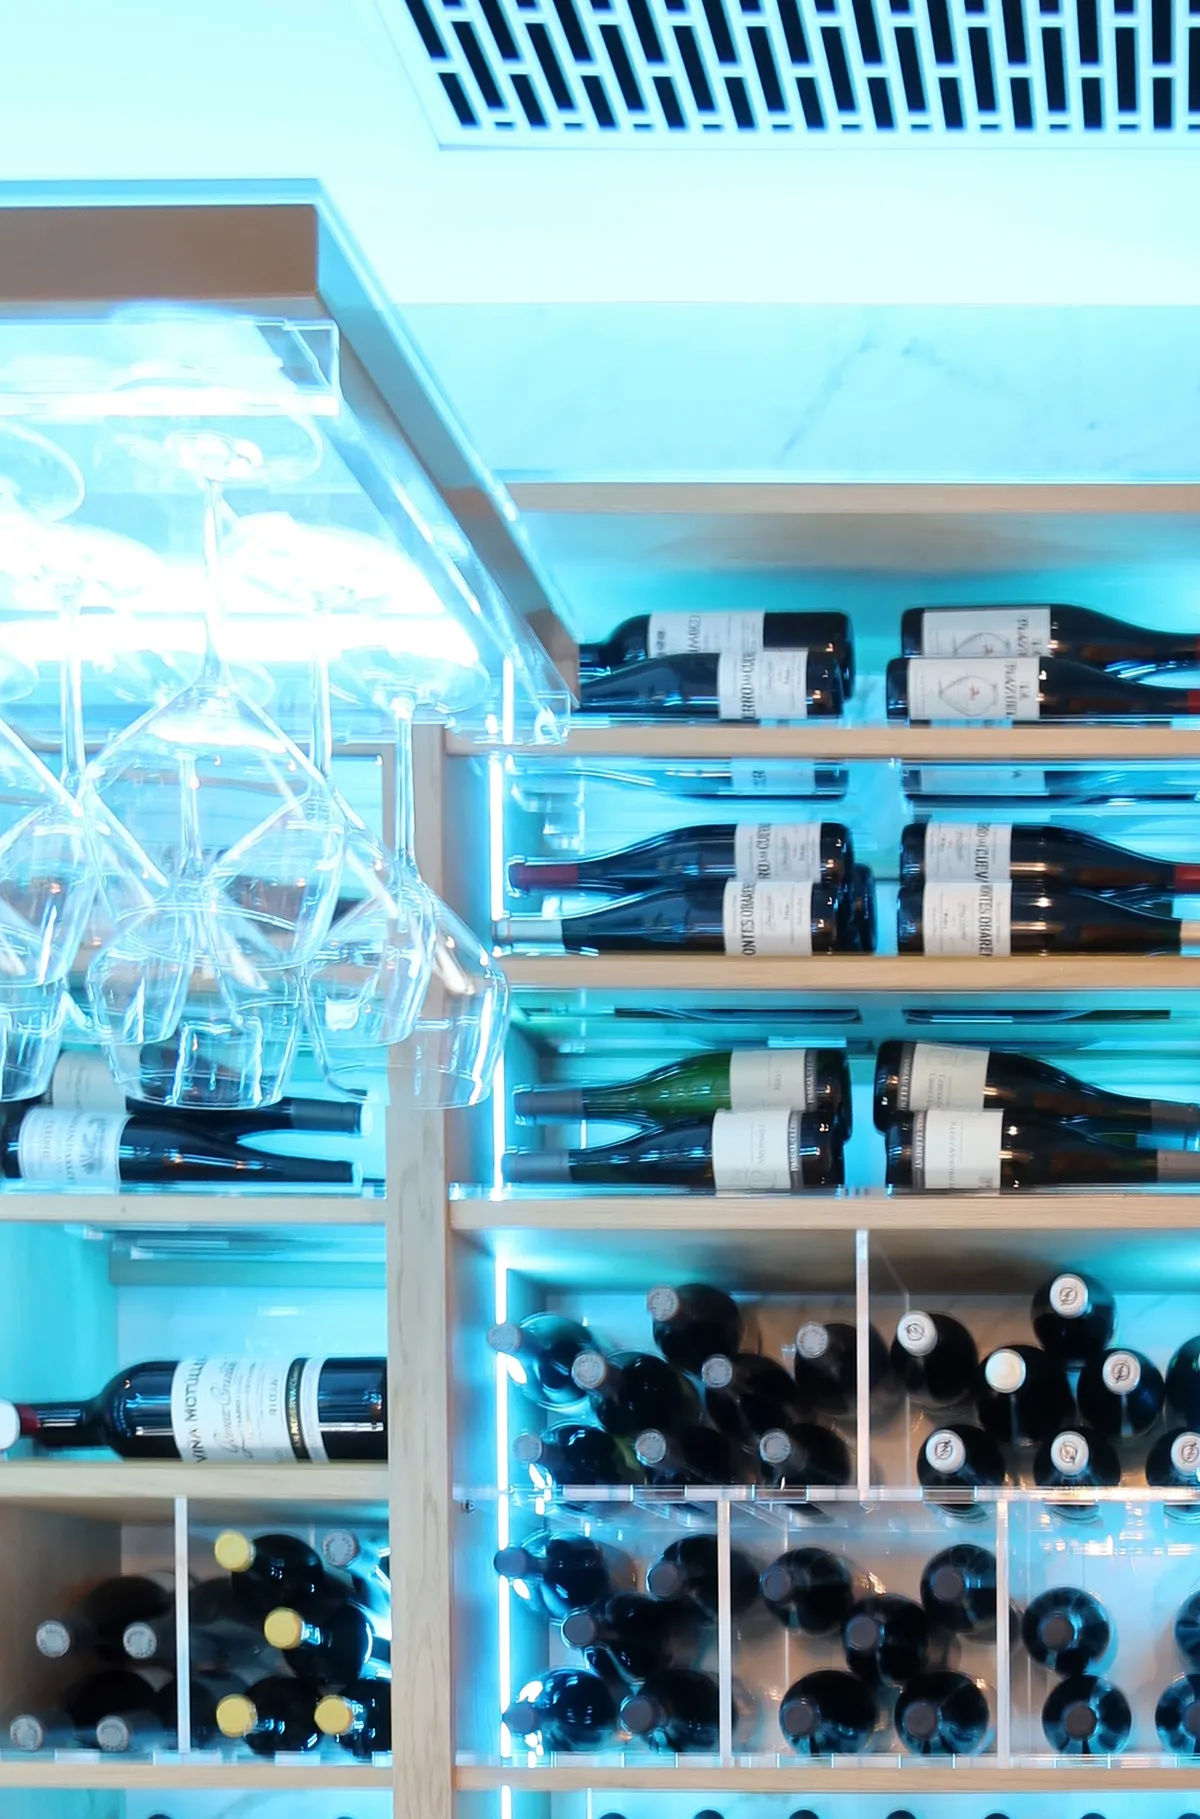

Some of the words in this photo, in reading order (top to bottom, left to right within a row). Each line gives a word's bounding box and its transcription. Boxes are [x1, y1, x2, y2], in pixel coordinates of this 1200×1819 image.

[740, 683, 756, 720] ERRO
[1003, 663, 1018, 720] PLAZUEL
[741, 919, 757, 956] ONTES
